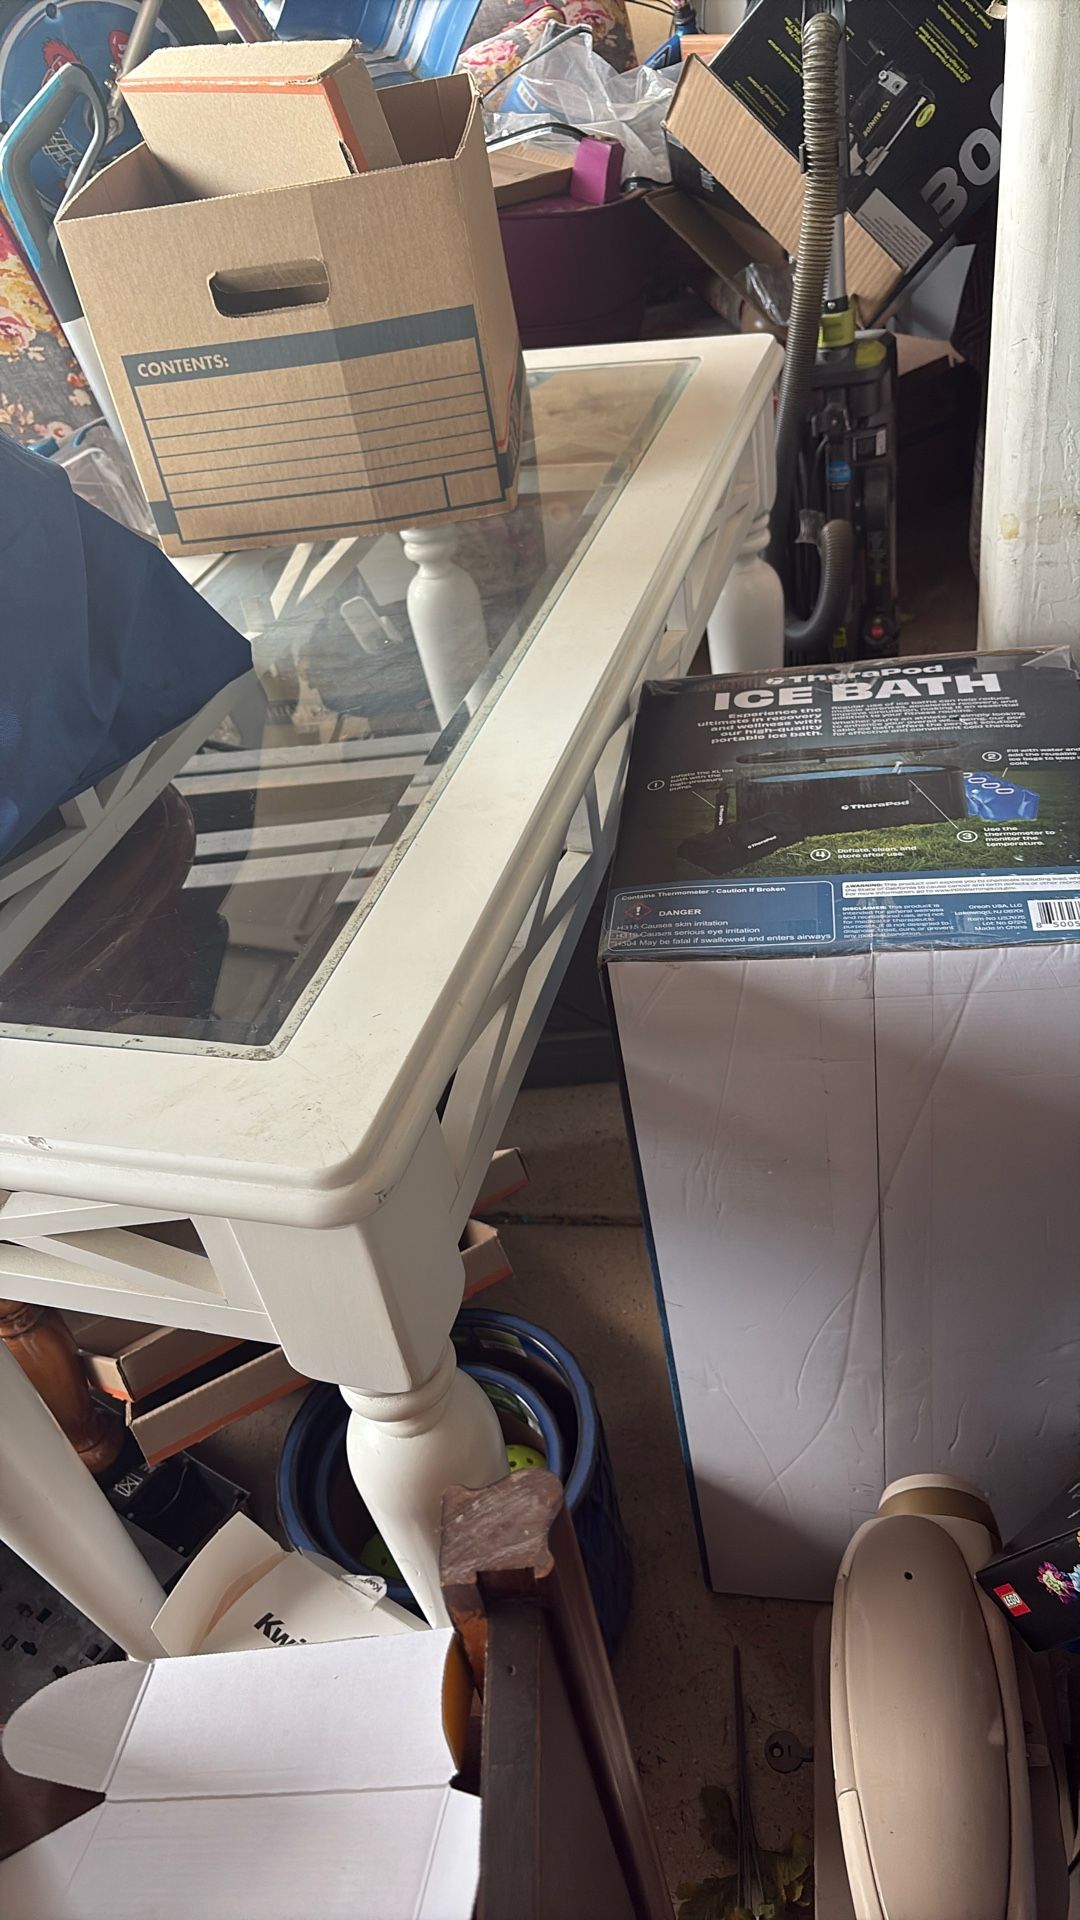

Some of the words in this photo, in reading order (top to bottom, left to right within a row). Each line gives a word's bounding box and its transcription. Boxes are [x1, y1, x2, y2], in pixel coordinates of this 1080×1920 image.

[137, 354, 230, 377] CONTENTS:
[789, 664, 943, 684] TheraPod
[714, 686, 813, 711] ICE
[832, 673, 1001, 702] BATH
[697, 718, 749, 727] ultimate
[766, 713, 822, 722] recovery
[728, 710, 798, 720] Experience
[737, 721, 792, 731] wellness
[745, 725, 822, 735] high-quality
[711, 734, 765, 744] portable
[850, 800, 910, 810] TheraPod
[621, 893, 655, 901] Contains
[658, 889, 709, 897] Thermometer
[658, 908, 702, 917] DANGER
[641, 922, 673, 930] Causes
[674, 920, 692, 928] skin
[694, 919, 728, 927] irritation
[640, 930, 672, 938] Causes
[674, 928, 705, 936] serious
[725, 926, 760, 934] irritation
[639, 940, 658, 948] May
[700, 935, 745, 944] swallowed
[797, 934, 831, 942] airways
[1003, 1592, 1021, 1608] LEGO
